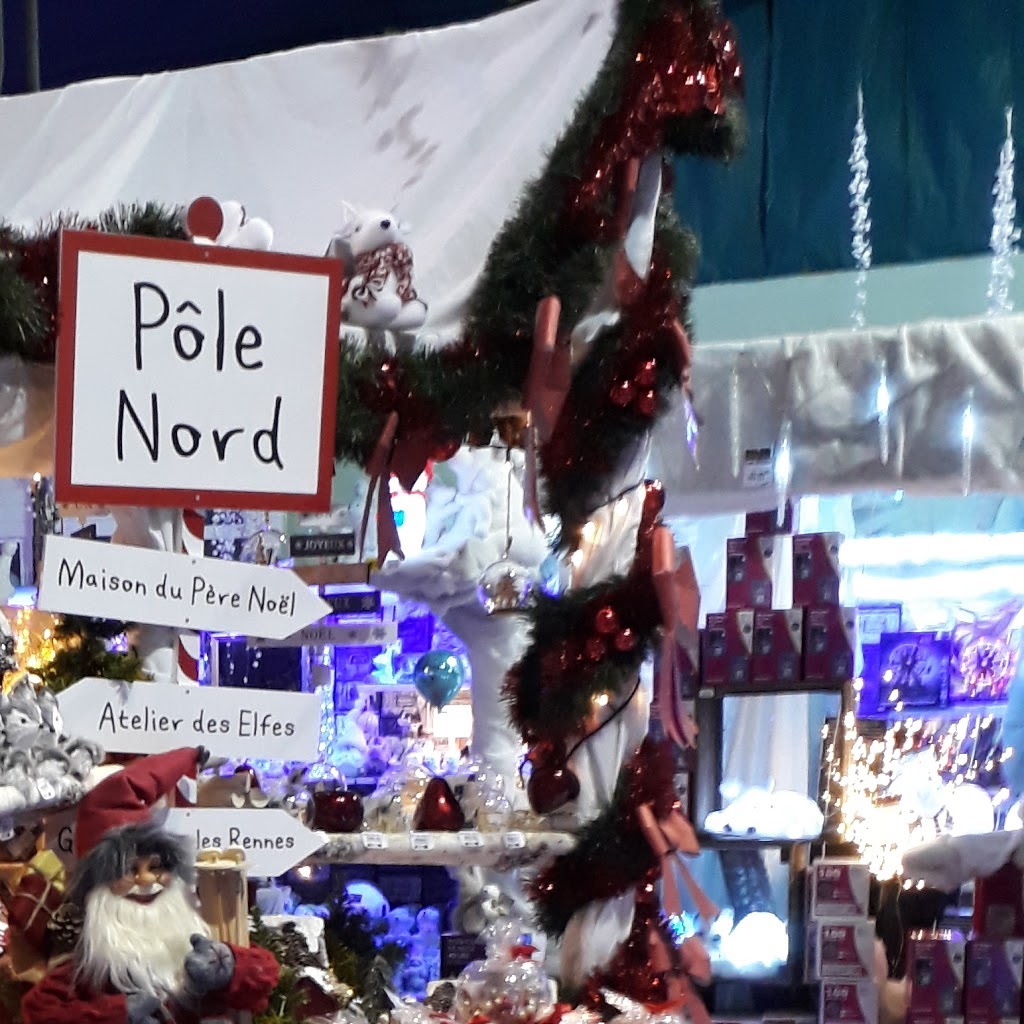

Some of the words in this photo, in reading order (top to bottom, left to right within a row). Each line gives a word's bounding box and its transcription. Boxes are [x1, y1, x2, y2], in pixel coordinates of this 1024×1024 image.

[133, 281, 264, 371] Pôle
[117, 389, 284, 470] Nord
[58, 558, 148, 597] Maison
[155, 574, 183, 601] du
[191, 576, 242, 609] Père
[247, 585, 297, 617] Noël
[99, 702, 184, 734] Atelier
[192, 709, 230, 734] des
[238, 709, 295, 737] Elfes
[196, 829, 222, 849] les
[229, 827, 295, 850] Rennes
